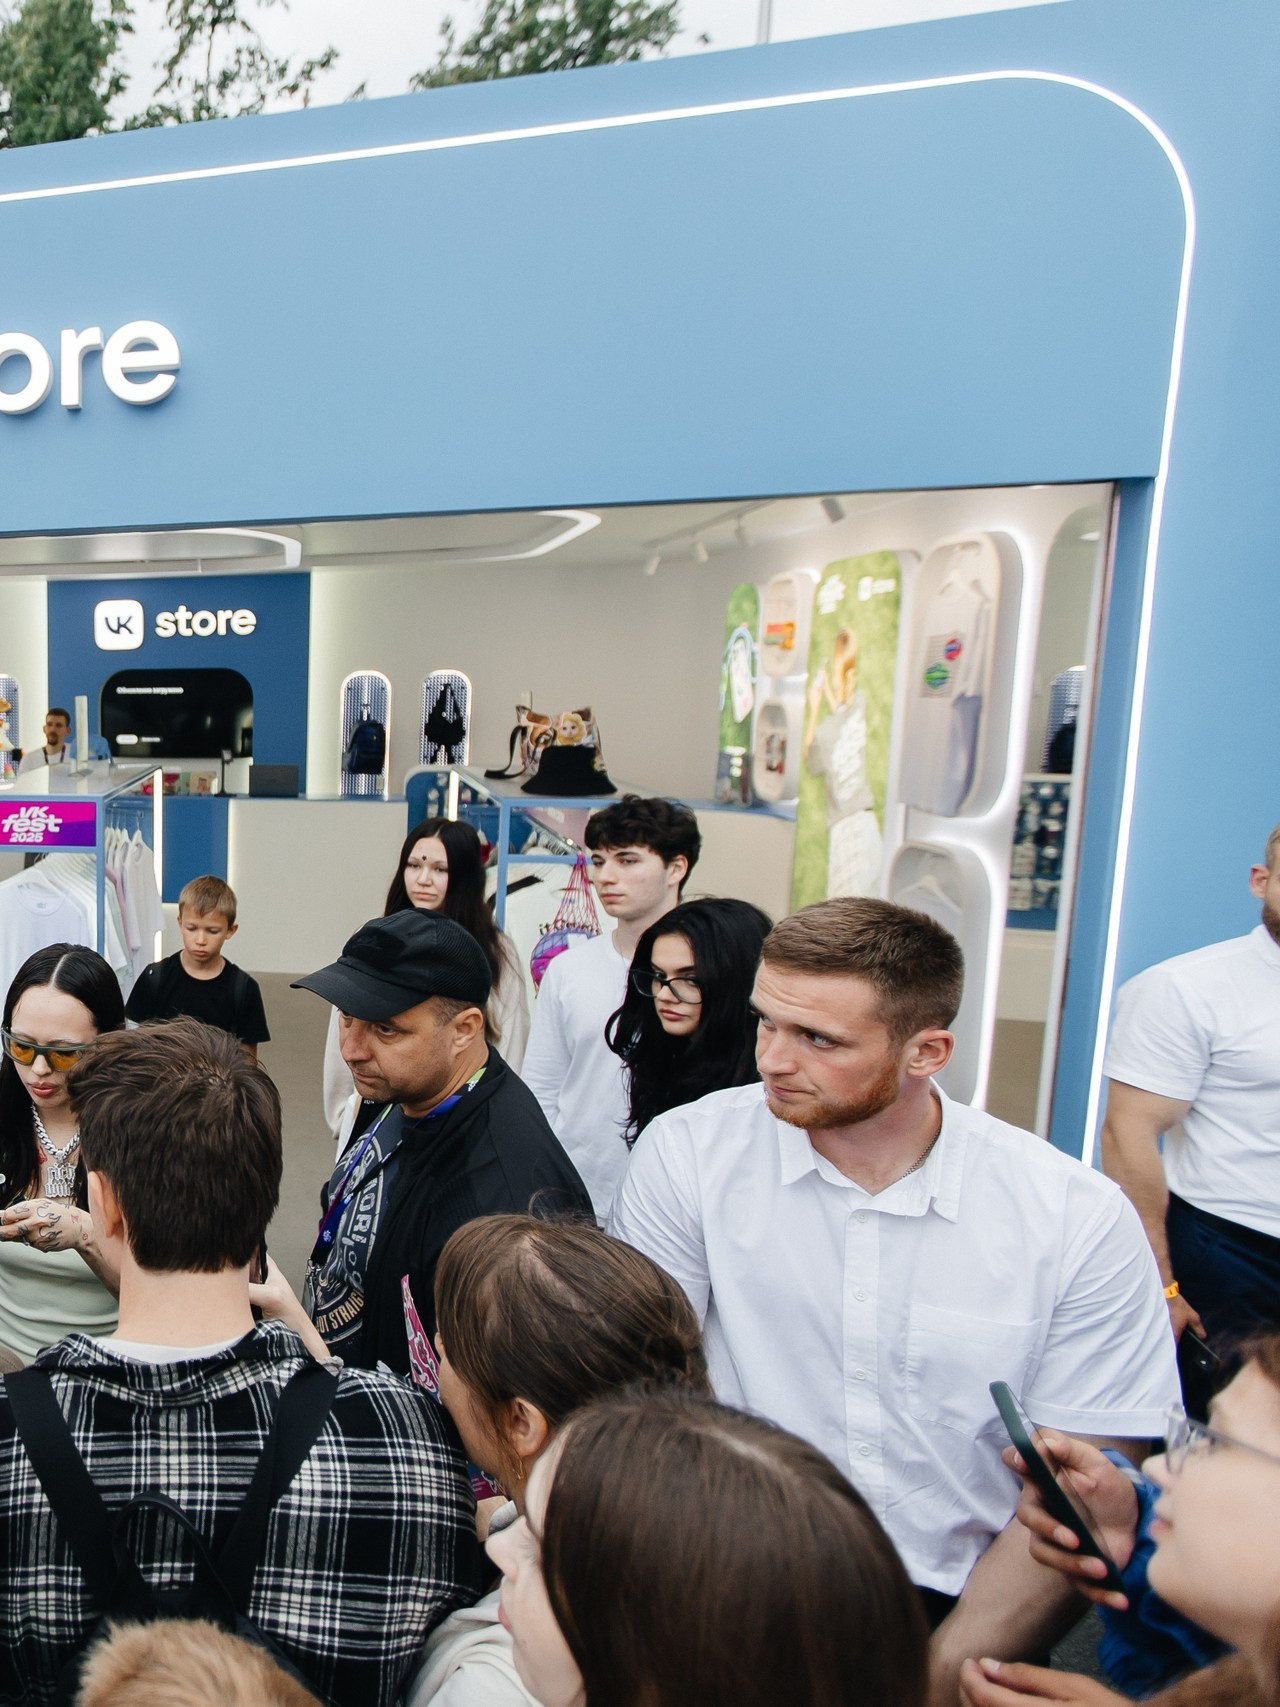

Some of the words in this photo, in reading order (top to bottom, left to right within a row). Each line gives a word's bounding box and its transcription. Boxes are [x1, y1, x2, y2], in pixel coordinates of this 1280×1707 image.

[154, 604, 258, 639] store
[19, 805, 50, 819] VK
[1, 813, 63, 833] fest
[9, 832, 44, 843] 2025
[329, 1288, 365, 1330] STRAIG
